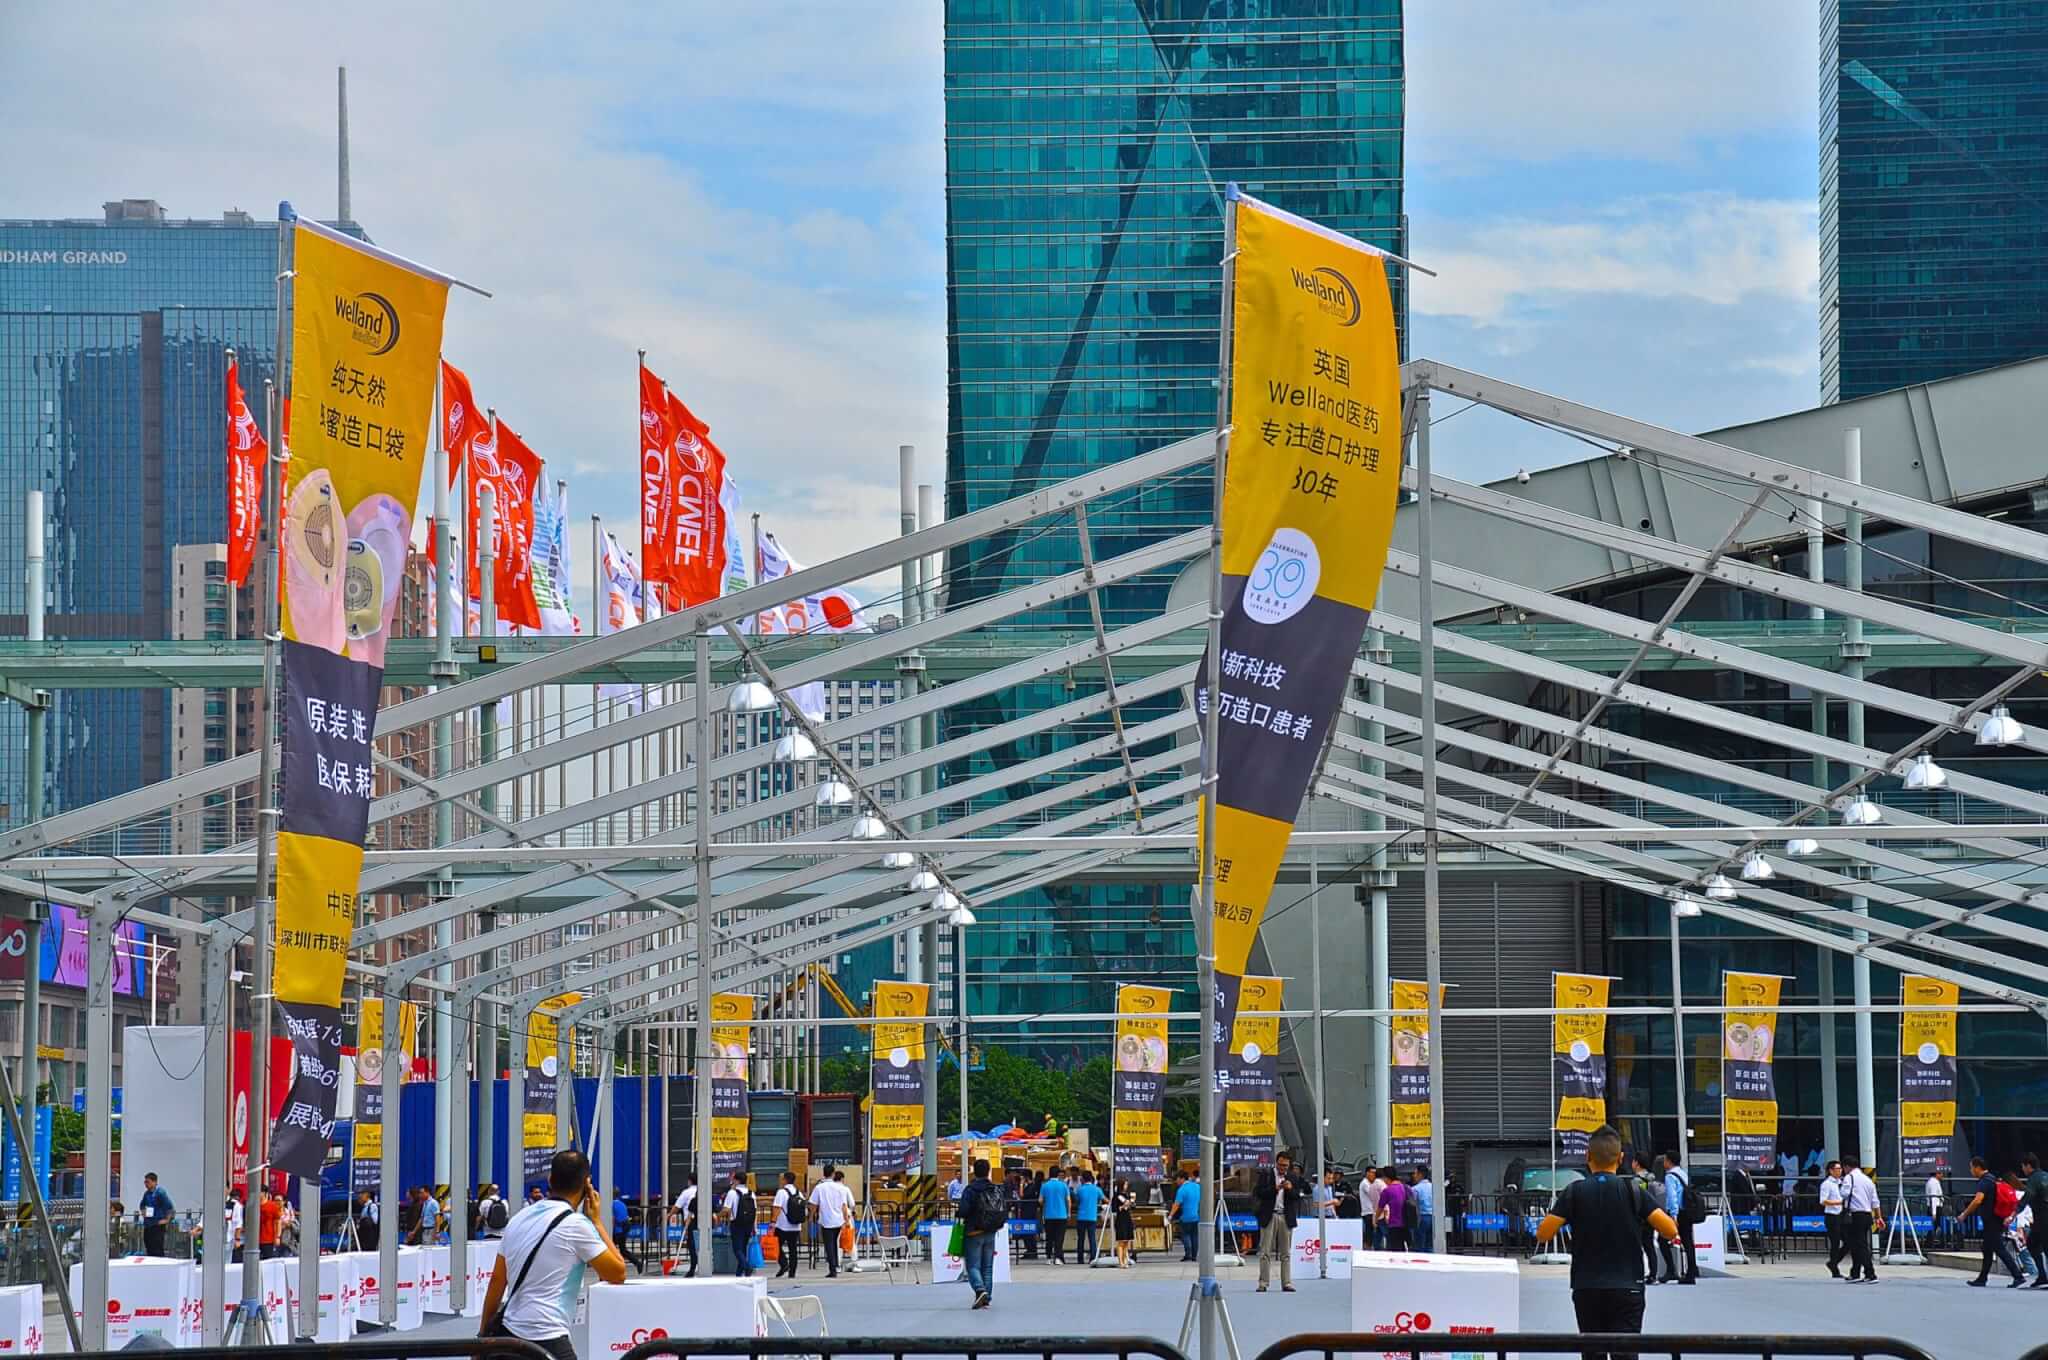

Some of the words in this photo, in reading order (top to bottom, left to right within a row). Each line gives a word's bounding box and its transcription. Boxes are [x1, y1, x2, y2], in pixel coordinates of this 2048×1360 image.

[0, 251, 57, 264] DHAM
[63, 251, 127, 264] GRAND
[1291, 267, 1346, 306] Welland
[335, 295, 384, 335] Welland
[331, 359, 387, 408] 纯天然
[1313, 347, 1350, 389] 英国
[1268, 379, 1379, 434] Welland医药
[1261, 418, 1380, 473] 专注造口护理
[1252, 549, 1306, 599] 30
[1214, 854, 1233, 883] 理
